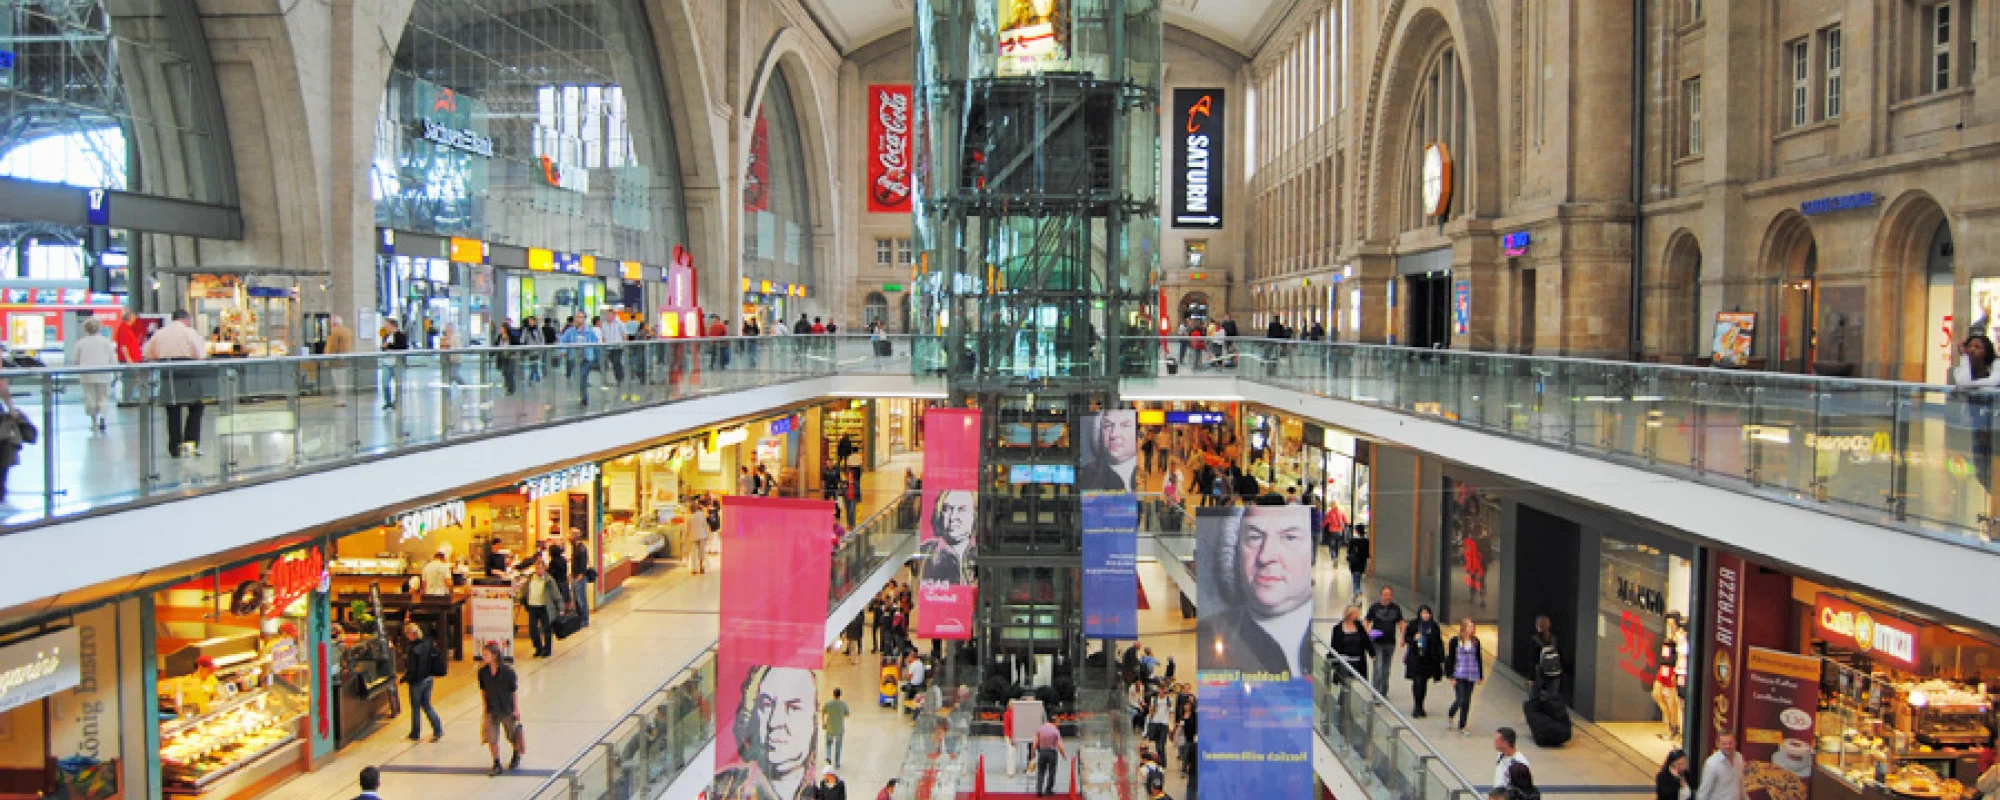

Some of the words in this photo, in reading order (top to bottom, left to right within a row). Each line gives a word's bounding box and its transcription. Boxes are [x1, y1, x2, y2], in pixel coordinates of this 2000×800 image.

[879, 91, 908, 170] Coca-Cola
[1186, 134, 1210, 213] SATURN
[1716, 566, 1737, 647] RITAZZA
